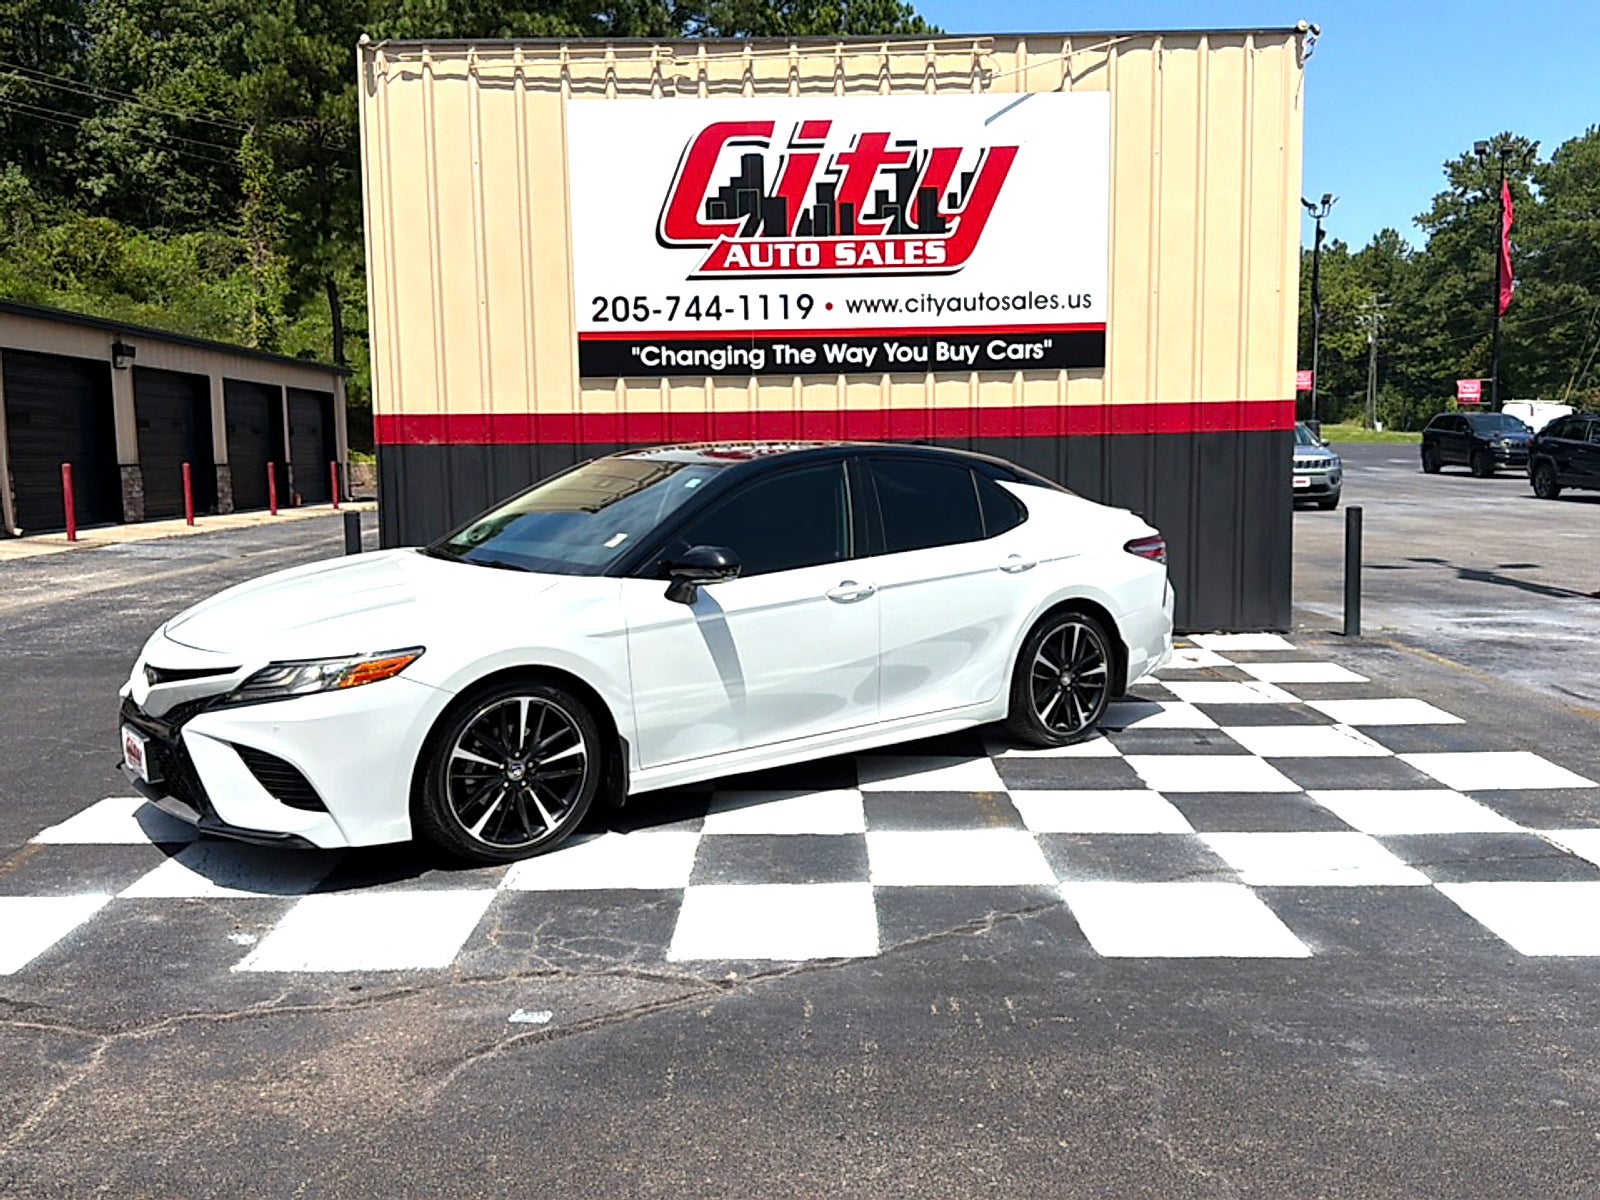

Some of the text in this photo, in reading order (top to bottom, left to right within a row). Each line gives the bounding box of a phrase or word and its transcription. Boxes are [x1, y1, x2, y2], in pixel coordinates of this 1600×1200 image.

[656, 119, 1018, 262] City
[723, 240, 946, 268] AUTO SALES
[591, 291, 1092, 322] 205-744-1119 www.cityautosales.us
[630, 338, 1053, 370] "Changing The Way You Buy Cars"
